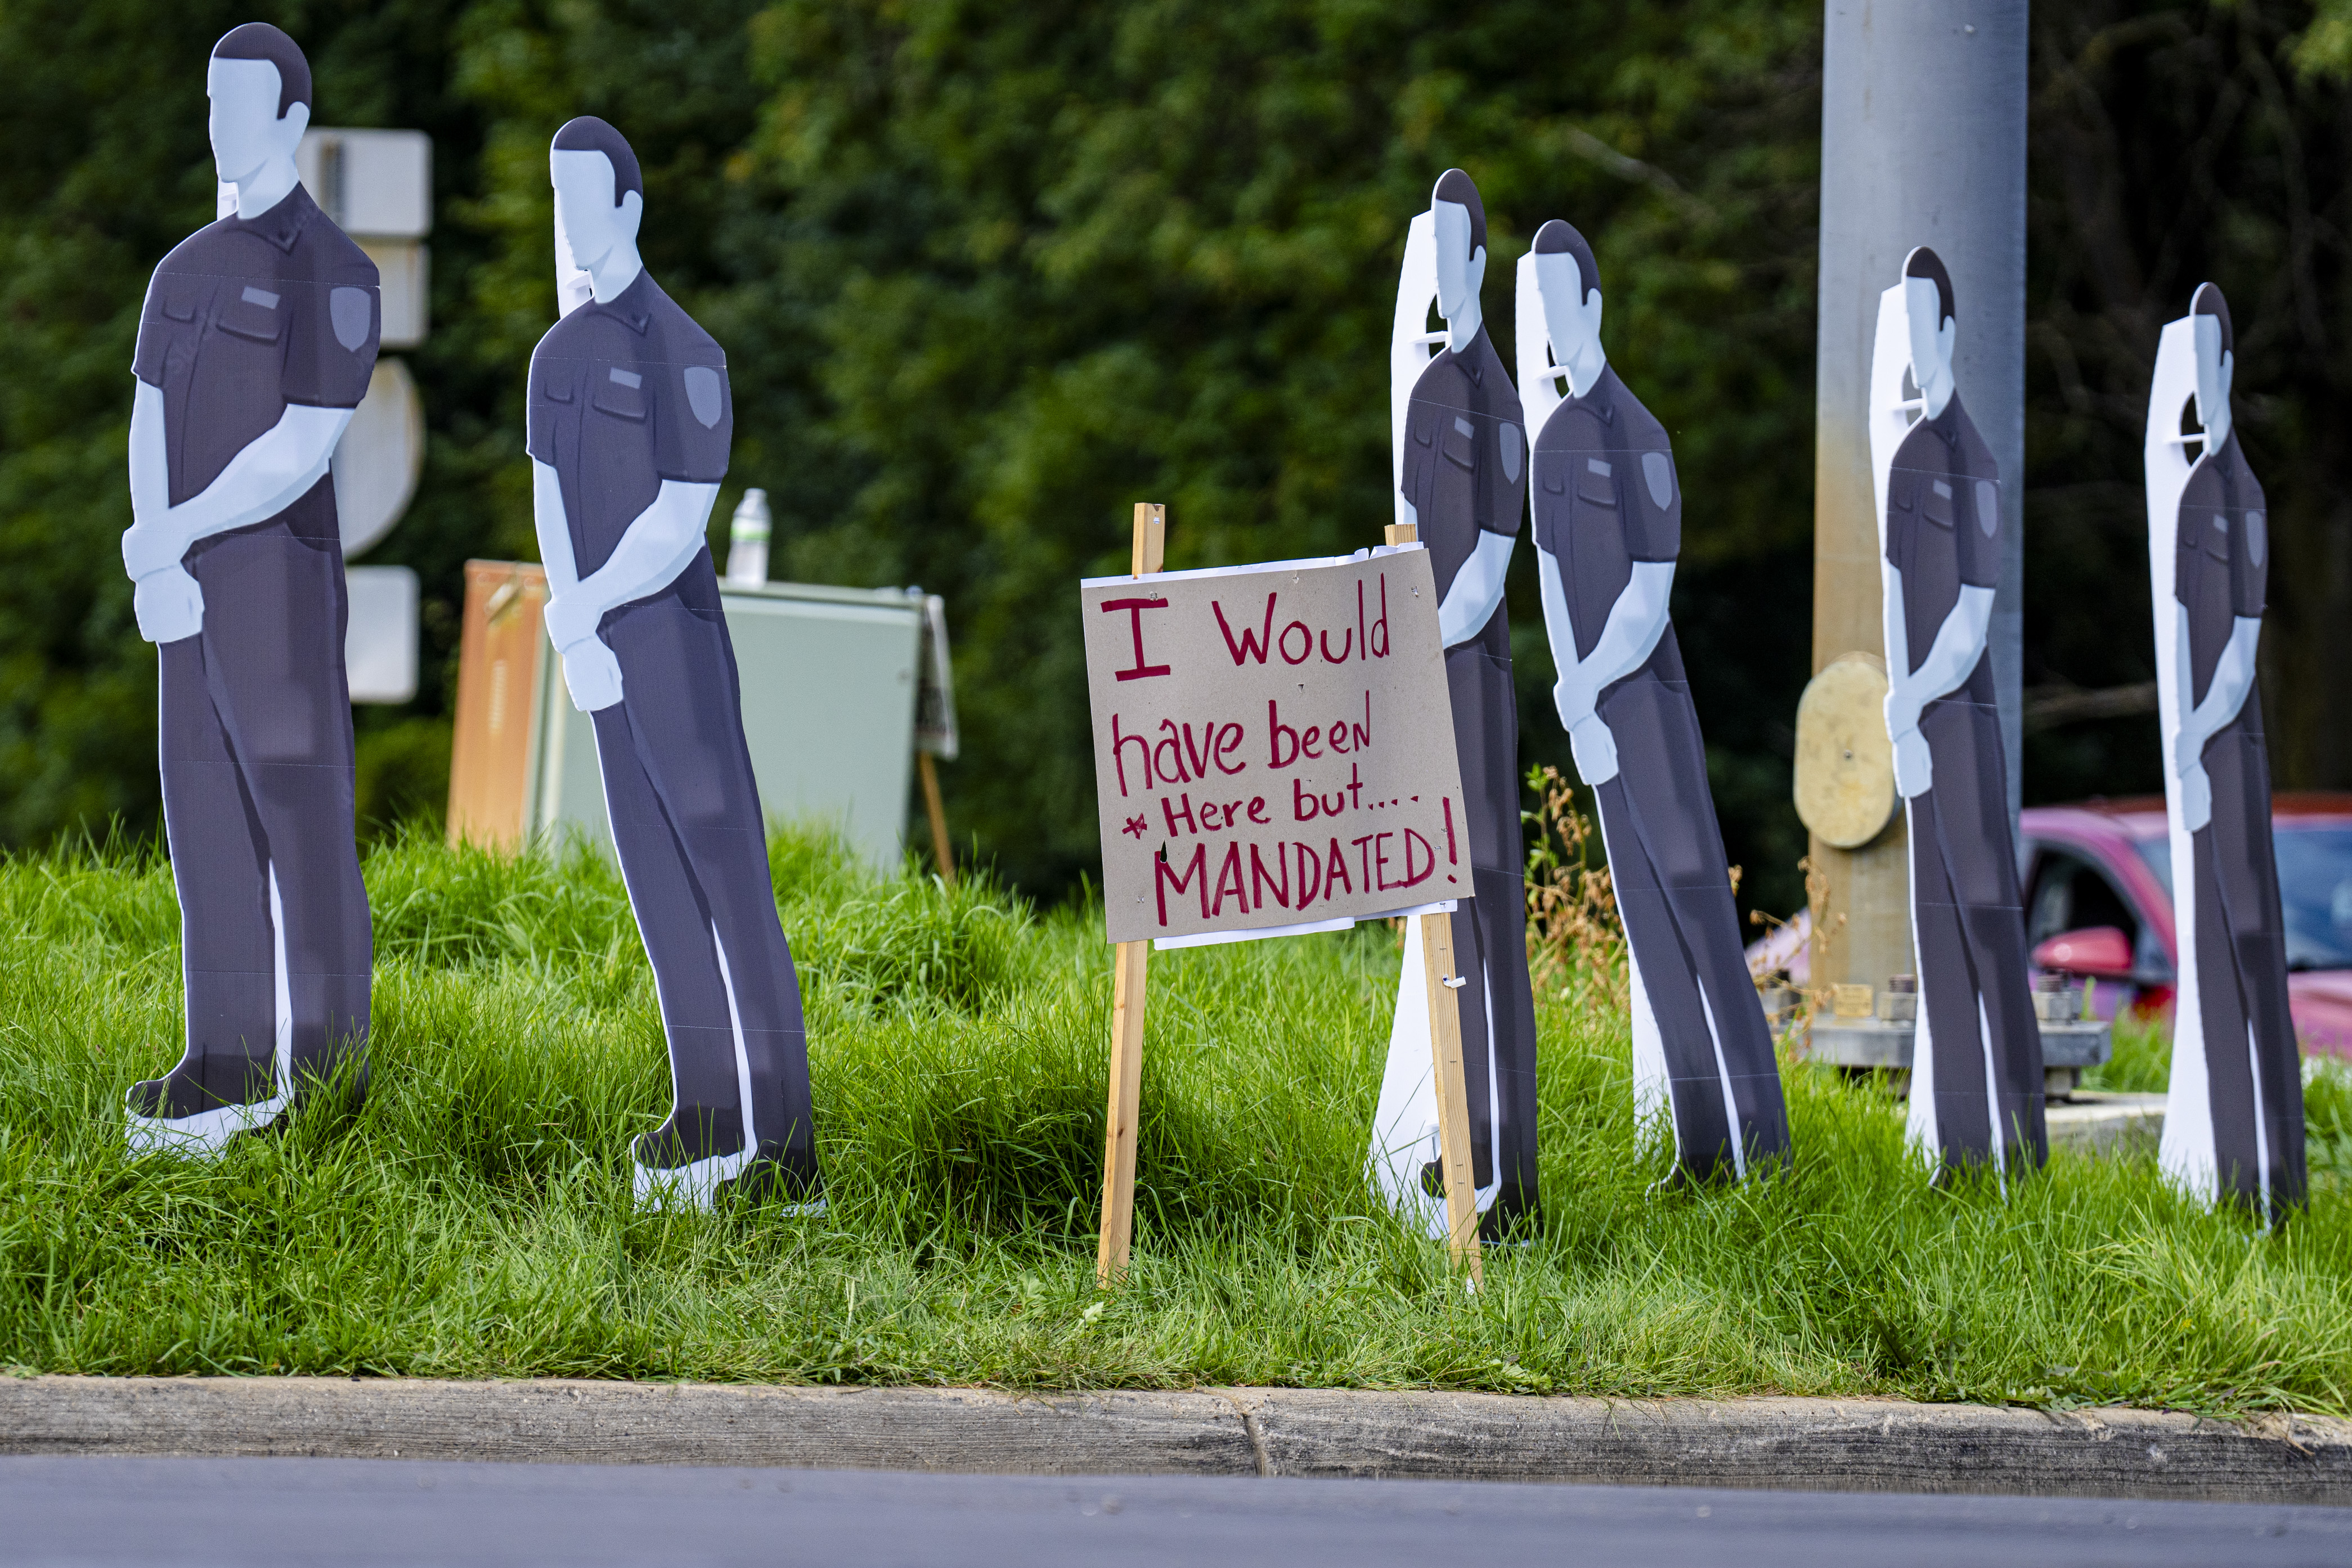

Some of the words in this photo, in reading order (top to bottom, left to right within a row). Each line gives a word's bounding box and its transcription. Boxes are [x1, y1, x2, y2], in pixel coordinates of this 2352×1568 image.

[1100, 597, 1171, 682] I
[1211, 572, 1390, 666] Would
[1112, 713, 1246, 797] have
[1154, 796, 1458, 927] MANDATED!
[1161, 793, 1272, 838] Here
